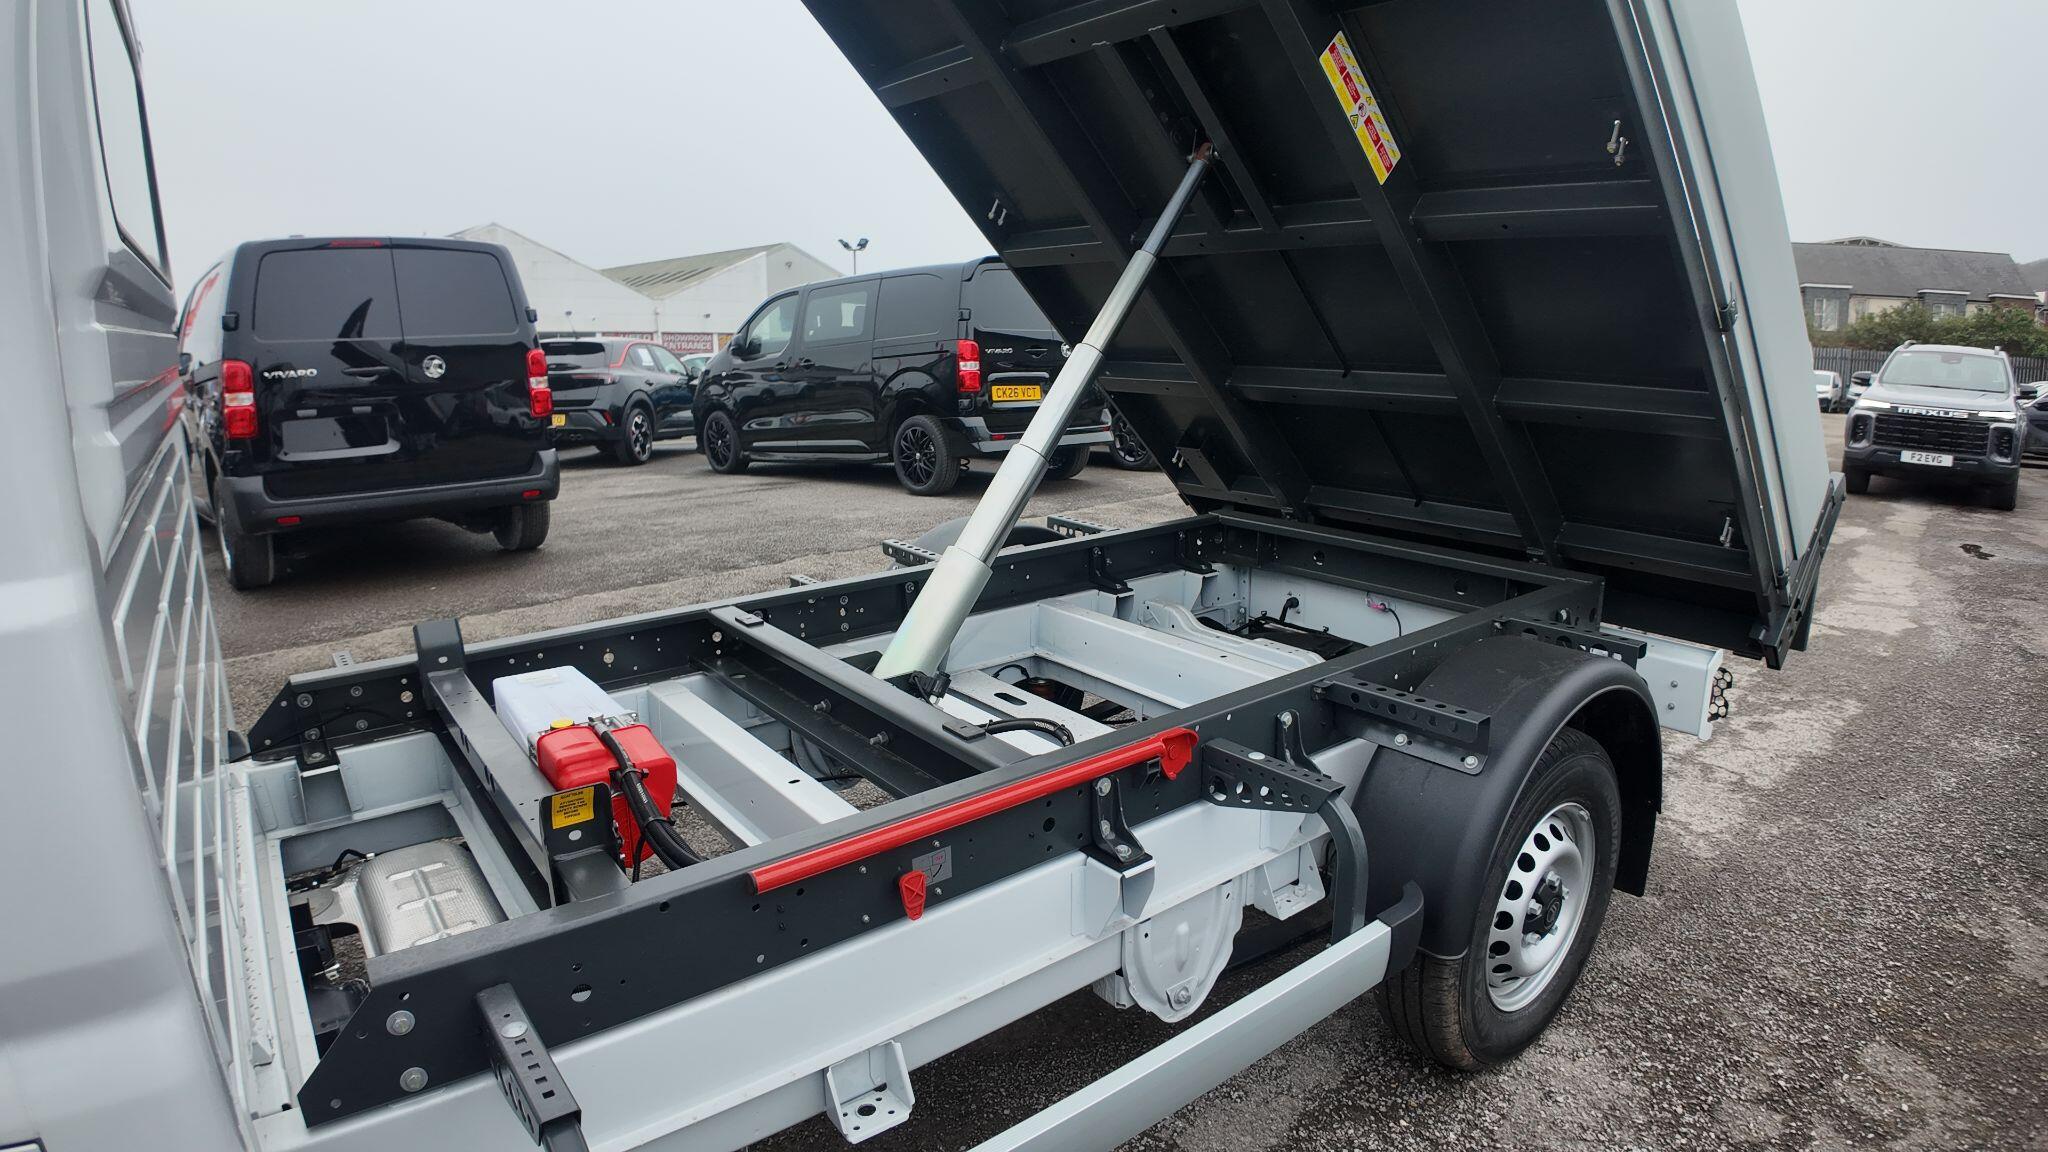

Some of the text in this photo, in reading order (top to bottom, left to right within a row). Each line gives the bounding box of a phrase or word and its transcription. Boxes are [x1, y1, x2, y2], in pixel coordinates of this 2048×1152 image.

[663, 334, 712, 342] SHOWROOM
[663, 341, 712, 350] ENTRANCE
[263, 368, 317, 379] VIVARO
[996, 387, 1037, 399] CK26 VCT
[1897, 406, 1969, 419] MAXUS
[1910, 452, 1943, 464] F2 EVG
